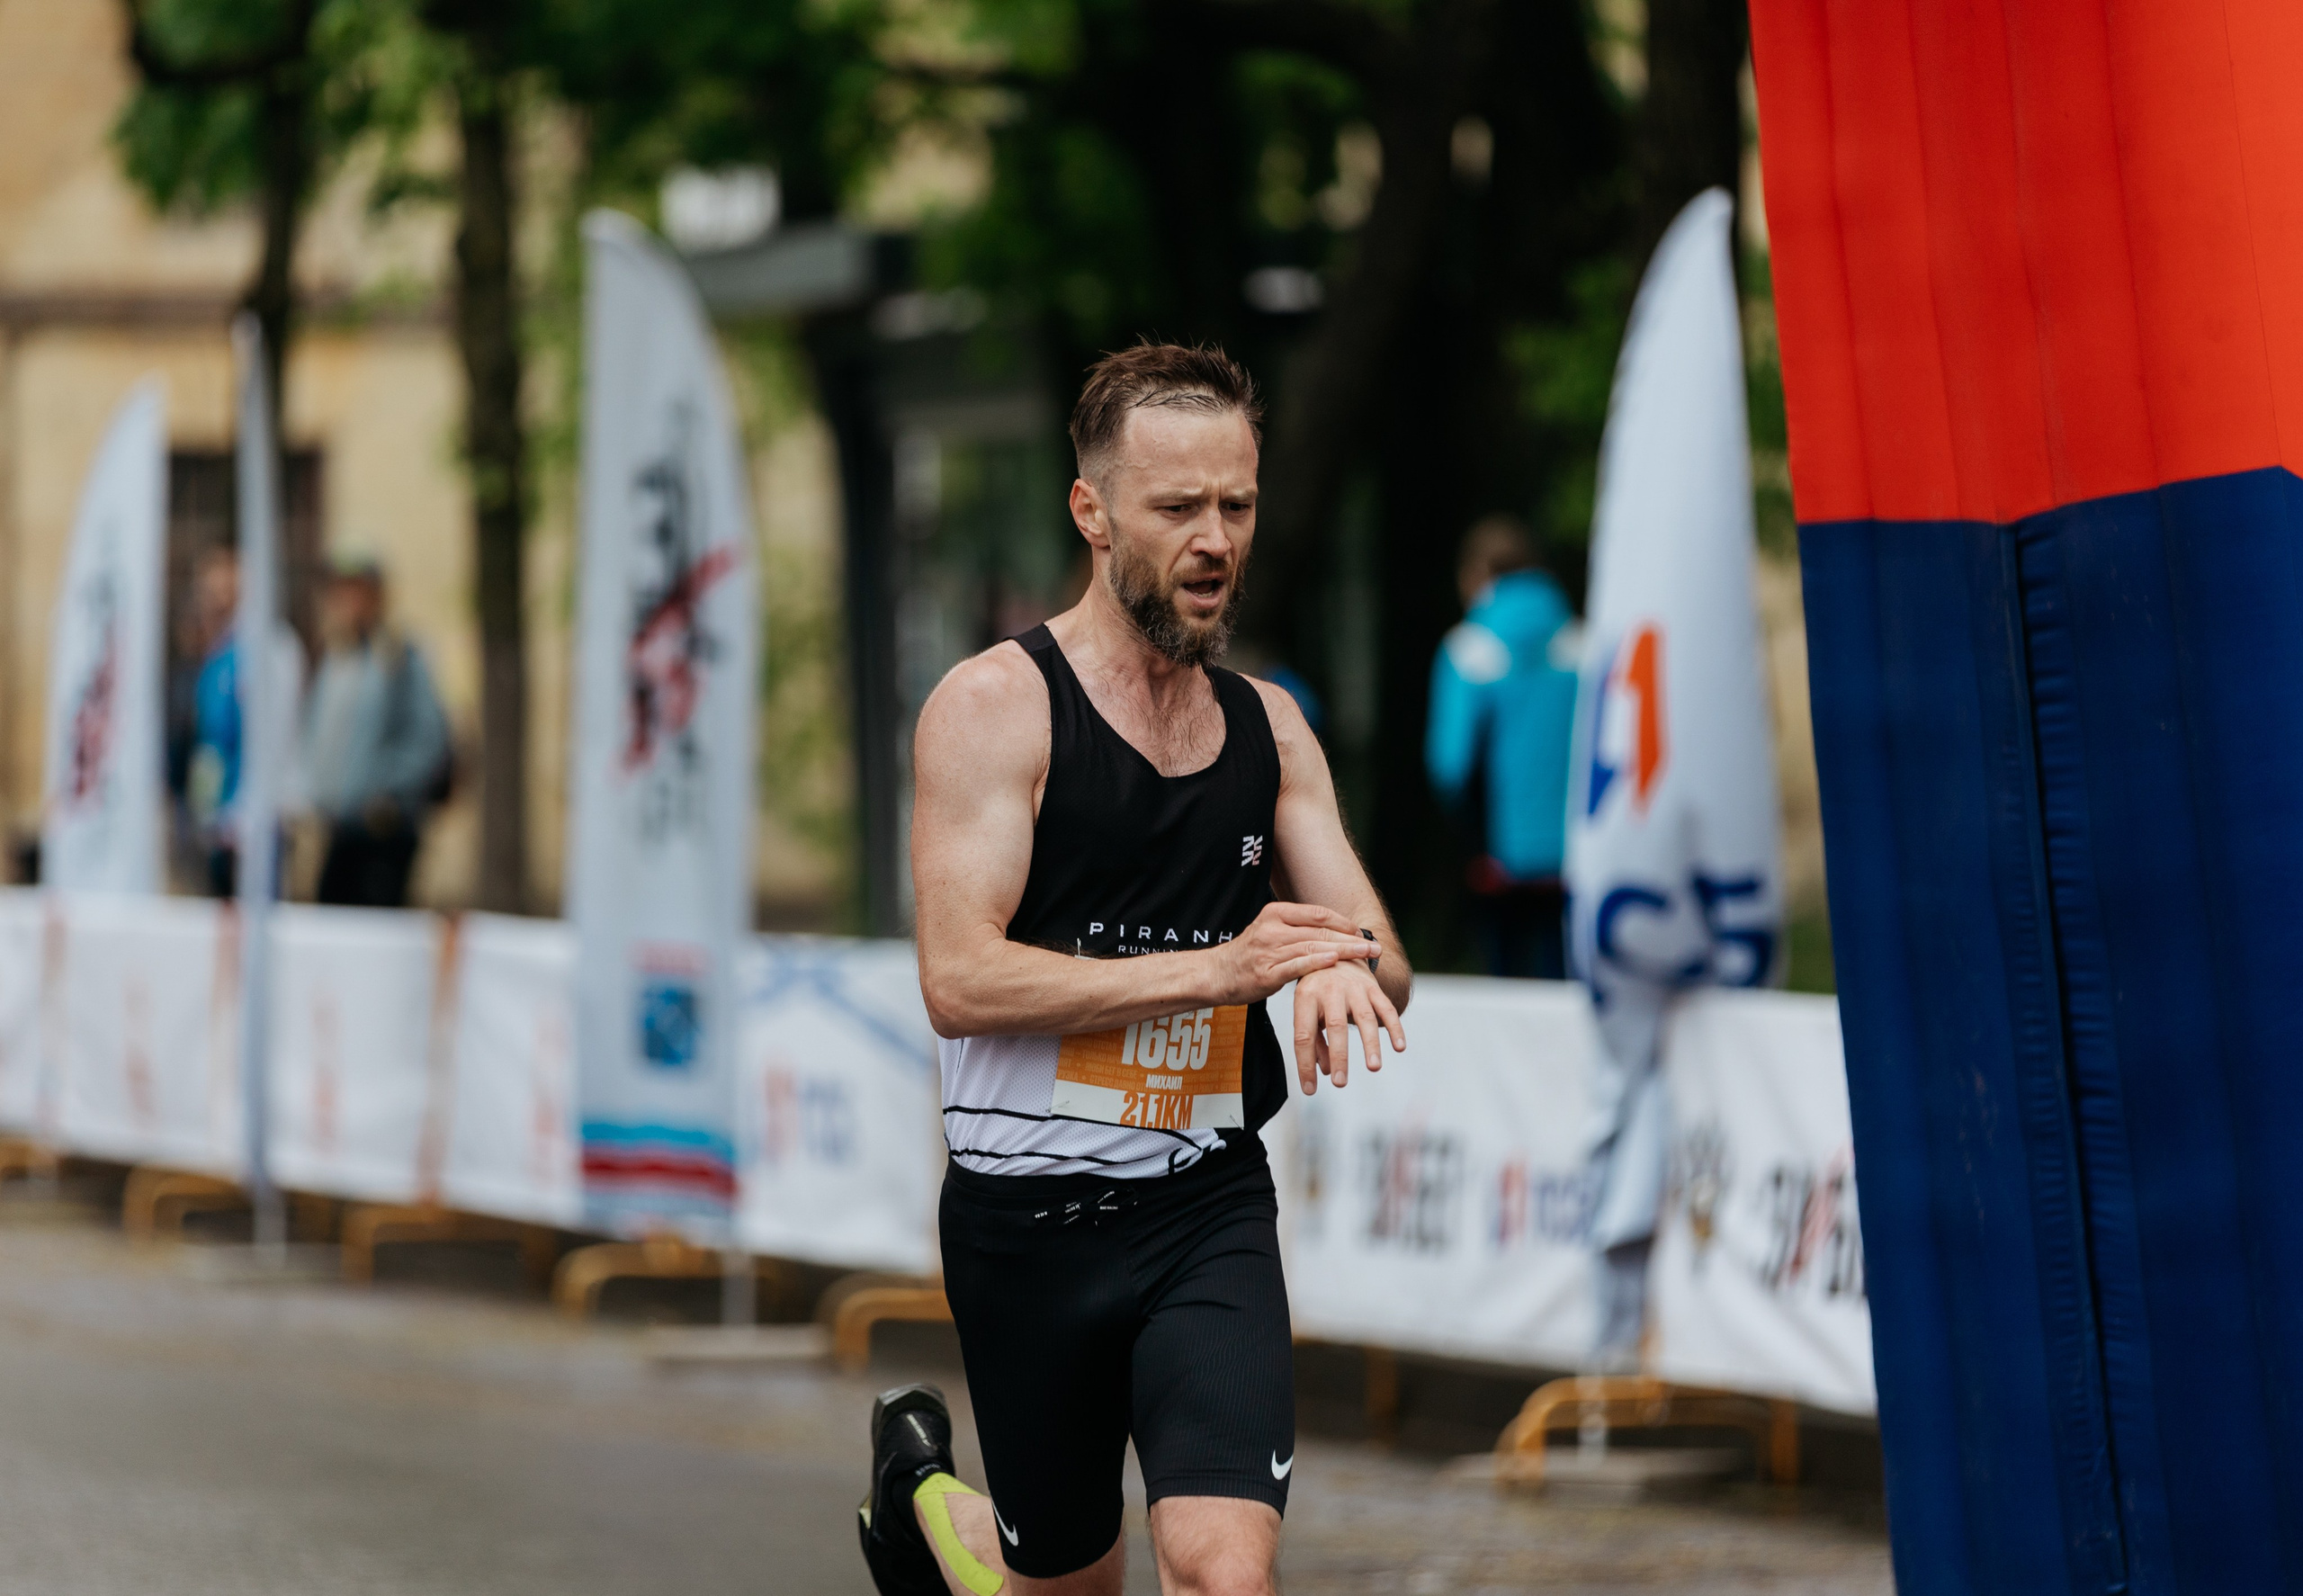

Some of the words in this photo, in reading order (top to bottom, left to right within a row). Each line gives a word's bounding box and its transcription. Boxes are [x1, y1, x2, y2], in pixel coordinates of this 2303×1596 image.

[1089, 921, 1233, 945] PIRANH
[1121, 1006, 1214, 1071] 1655
[1145, 1073, 1184, 1090] МИХАИЛ
